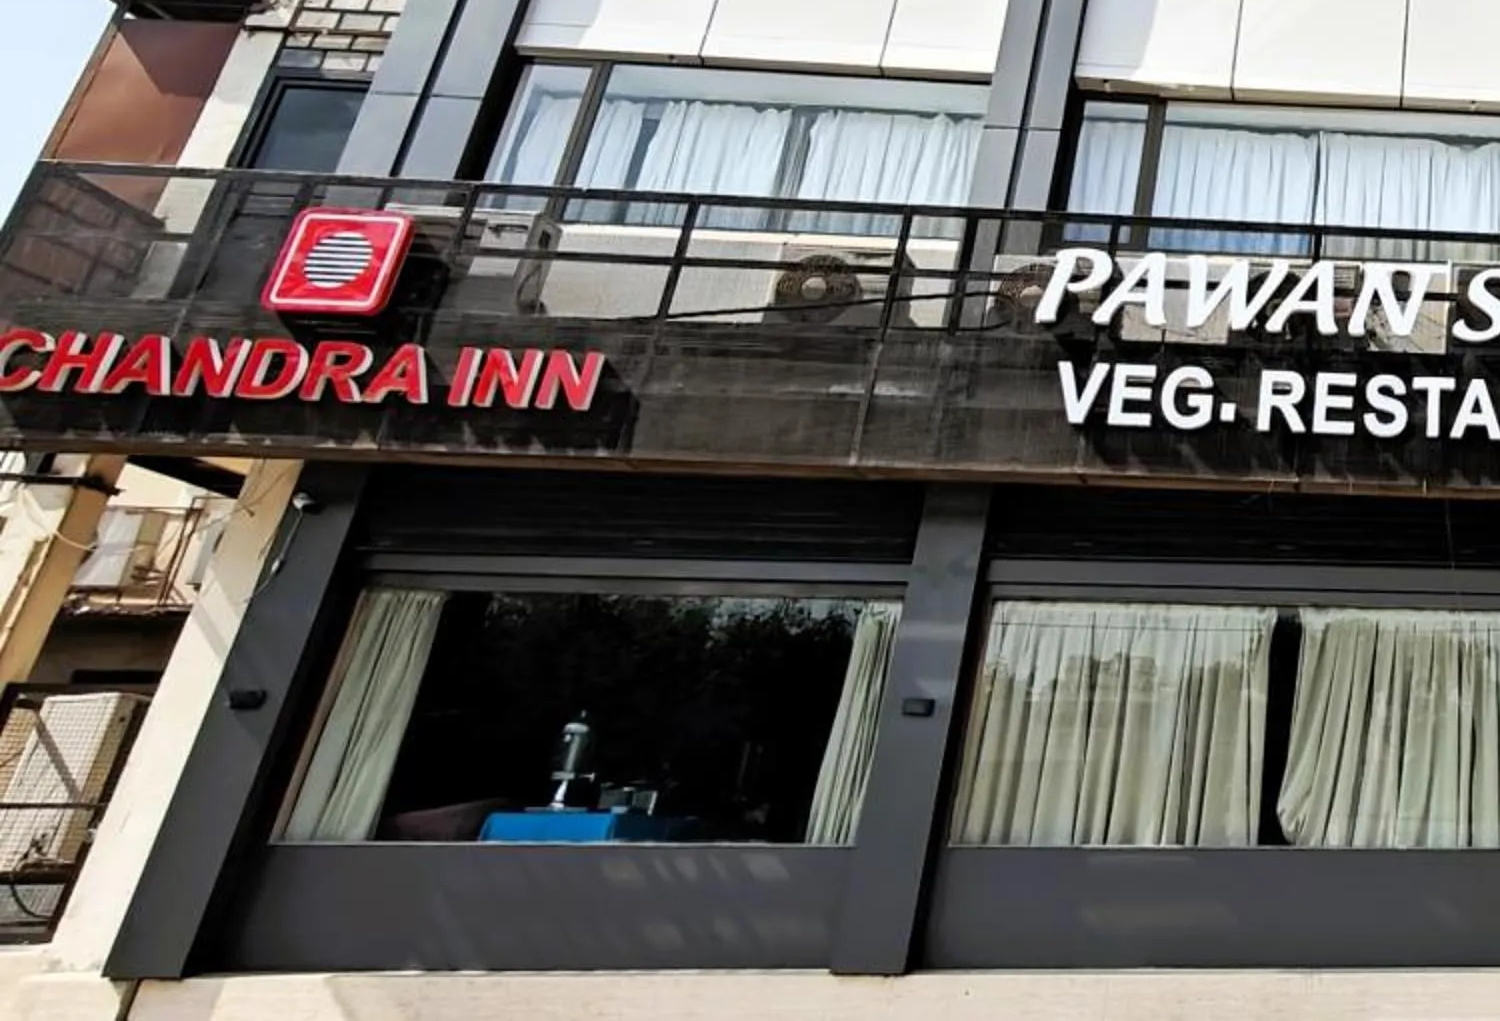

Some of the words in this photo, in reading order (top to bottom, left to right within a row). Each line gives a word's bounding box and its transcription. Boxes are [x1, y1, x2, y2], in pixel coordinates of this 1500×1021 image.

[1034, 247, 1437, 336] PAWAN
[0, 329, 427, 403] CHANDRA
[447, 347, 604, 410] INN
